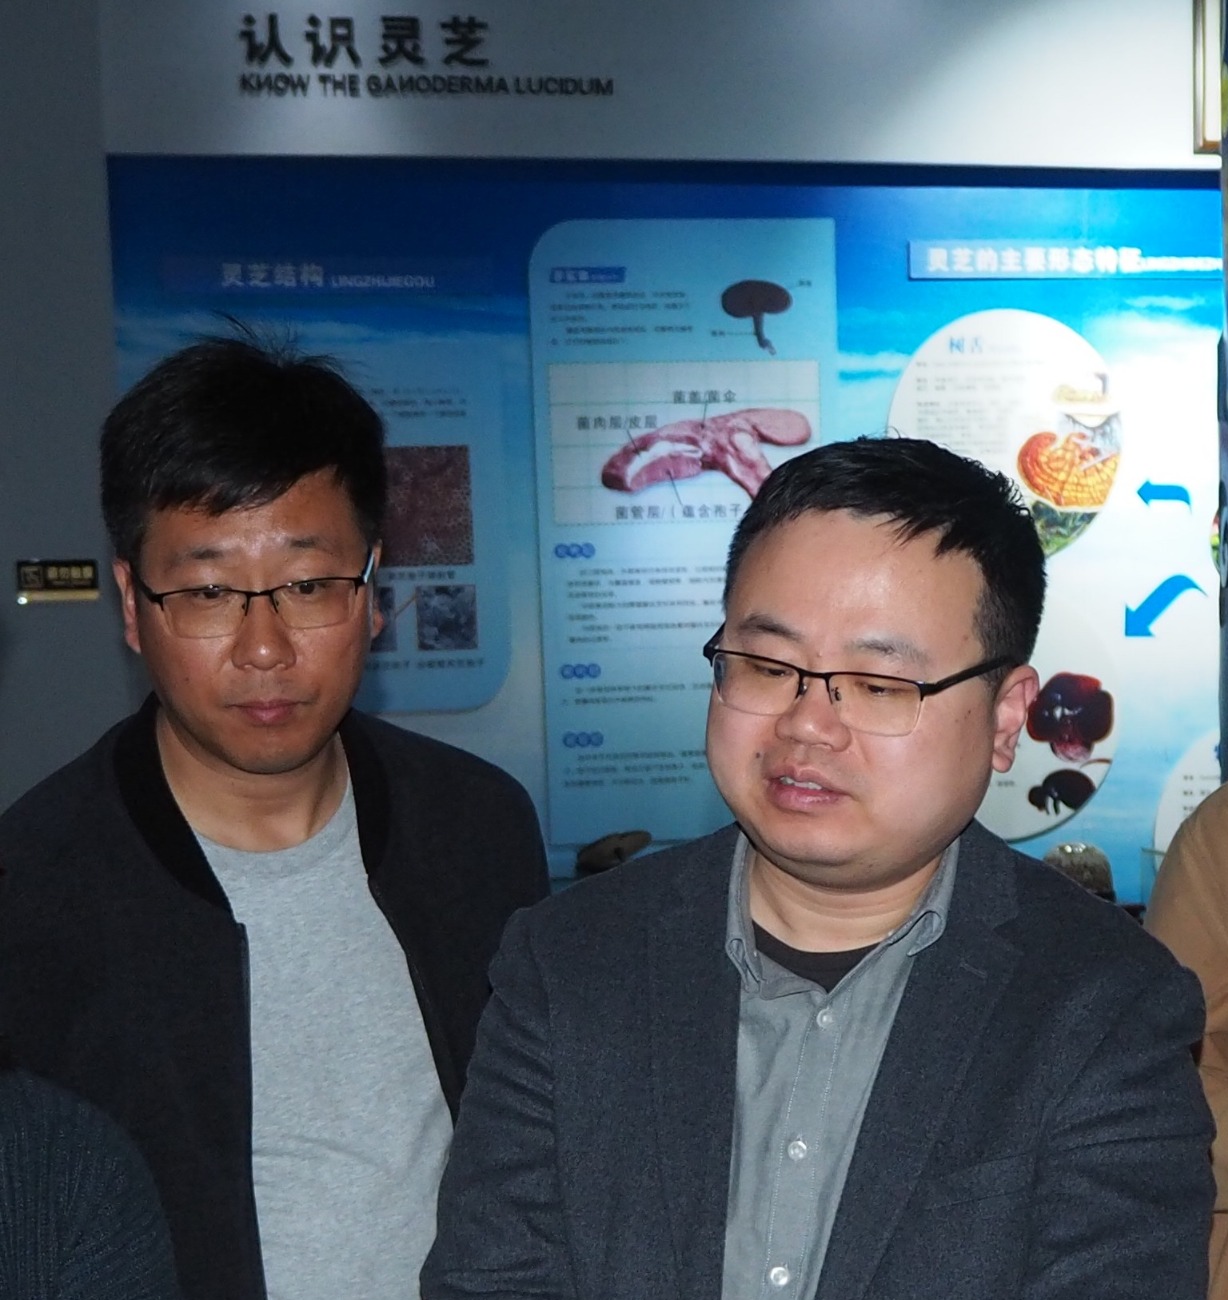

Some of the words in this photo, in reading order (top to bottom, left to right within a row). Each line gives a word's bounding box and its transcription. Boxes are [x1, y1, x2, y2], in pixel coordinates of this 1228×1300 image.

[240, 13, 490, 67] 认识灵芝
[240, 73, 309, 96] KNOW
[318, 74, 358, 97] THE
[367, 75, 510, 97] GANODERMA
[515, 77, 614, 97] LUCIDUM
[221, 263, 325, 288] 灵芝结构
